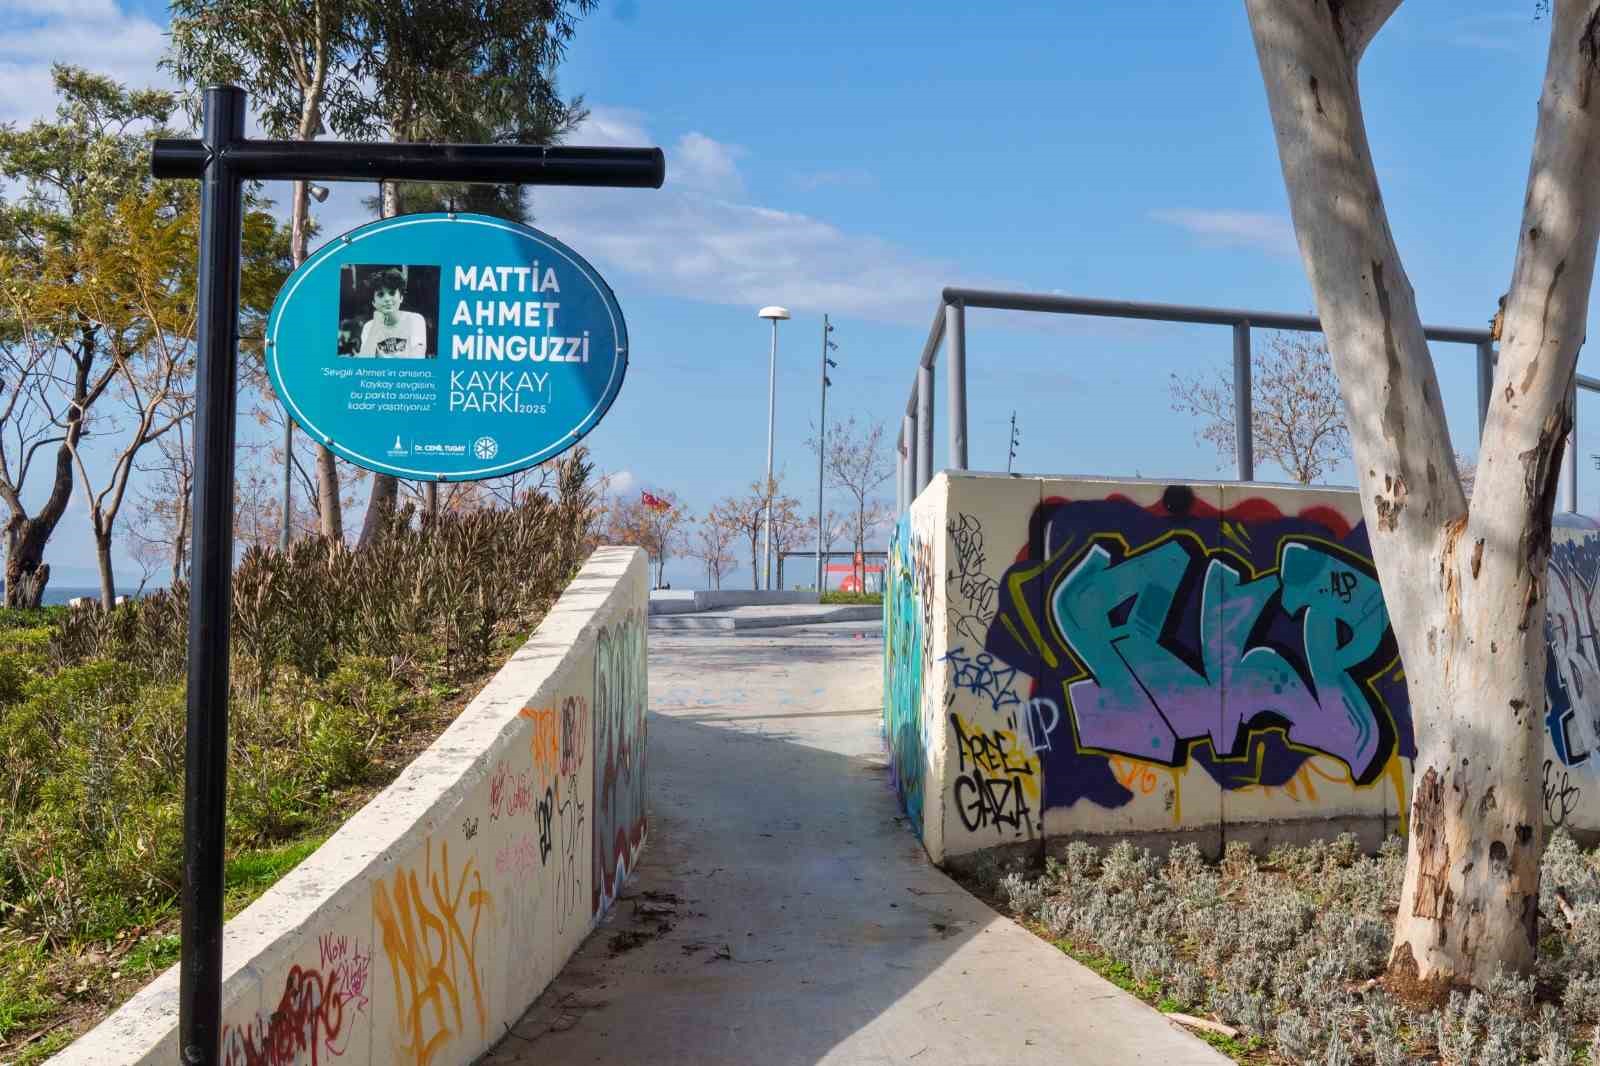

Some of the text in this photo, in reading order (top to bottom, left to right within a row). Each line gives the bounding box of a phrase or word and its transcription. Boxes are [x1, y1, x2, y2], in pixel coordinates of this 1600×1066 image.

[454, 259, 561, 293] MATTİA
[451, 299, 561, 328] AHMET
[451, 327, 590, 363] MİNGUZZİ
[450, 369, 549, 393] KAYKAY
[449, 391, 547, 415] PARKI 2025
[951, 712, 1033, 775] FREE
[953, 770, 1033, 838] GAZA
